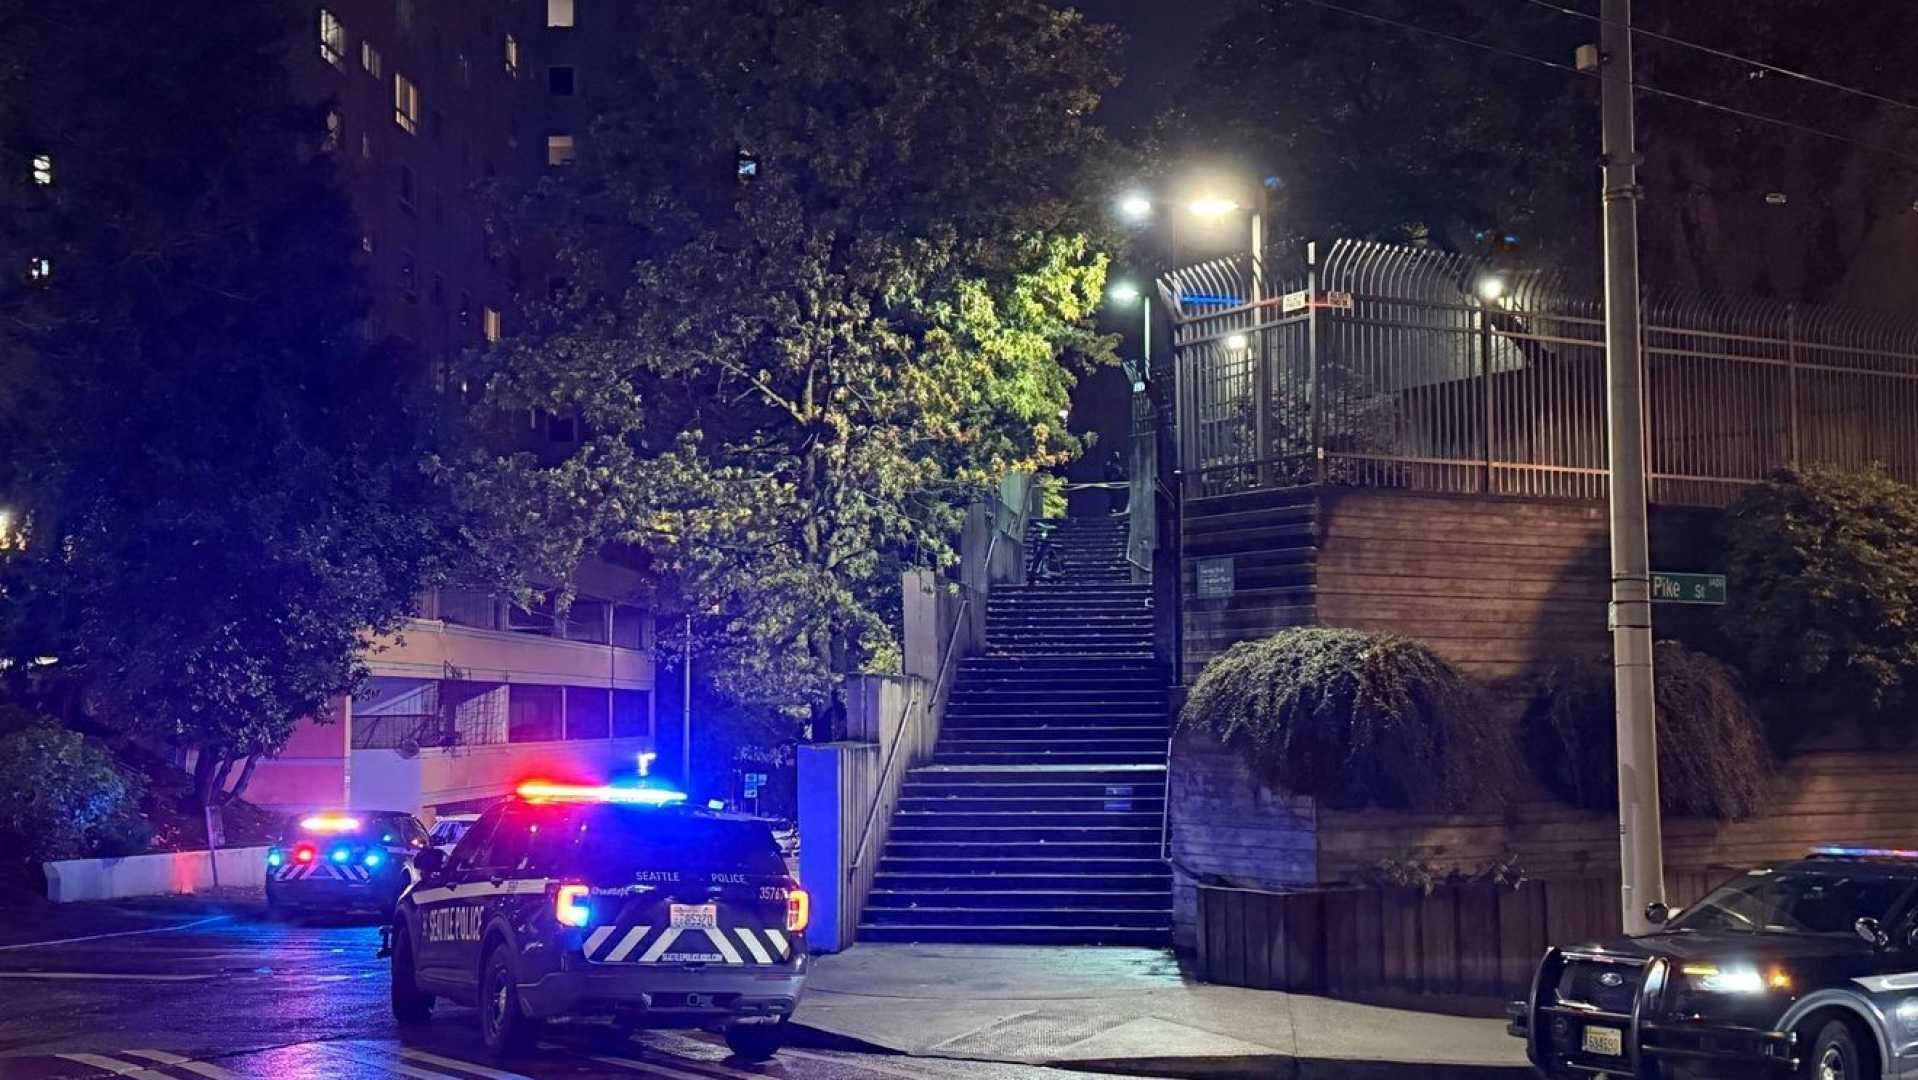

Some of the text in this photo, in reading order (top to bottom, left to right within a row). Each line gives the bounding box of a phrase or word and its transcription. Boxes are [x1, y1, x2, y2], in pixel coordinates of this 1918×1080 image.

[1654, 576, 1705, 599] Pike St
[635, 871, 745, 884] SEATTLE POLICE
[429, 908, 455, 942] SEATTLE
[455, 905, 485, 941] POLICE
